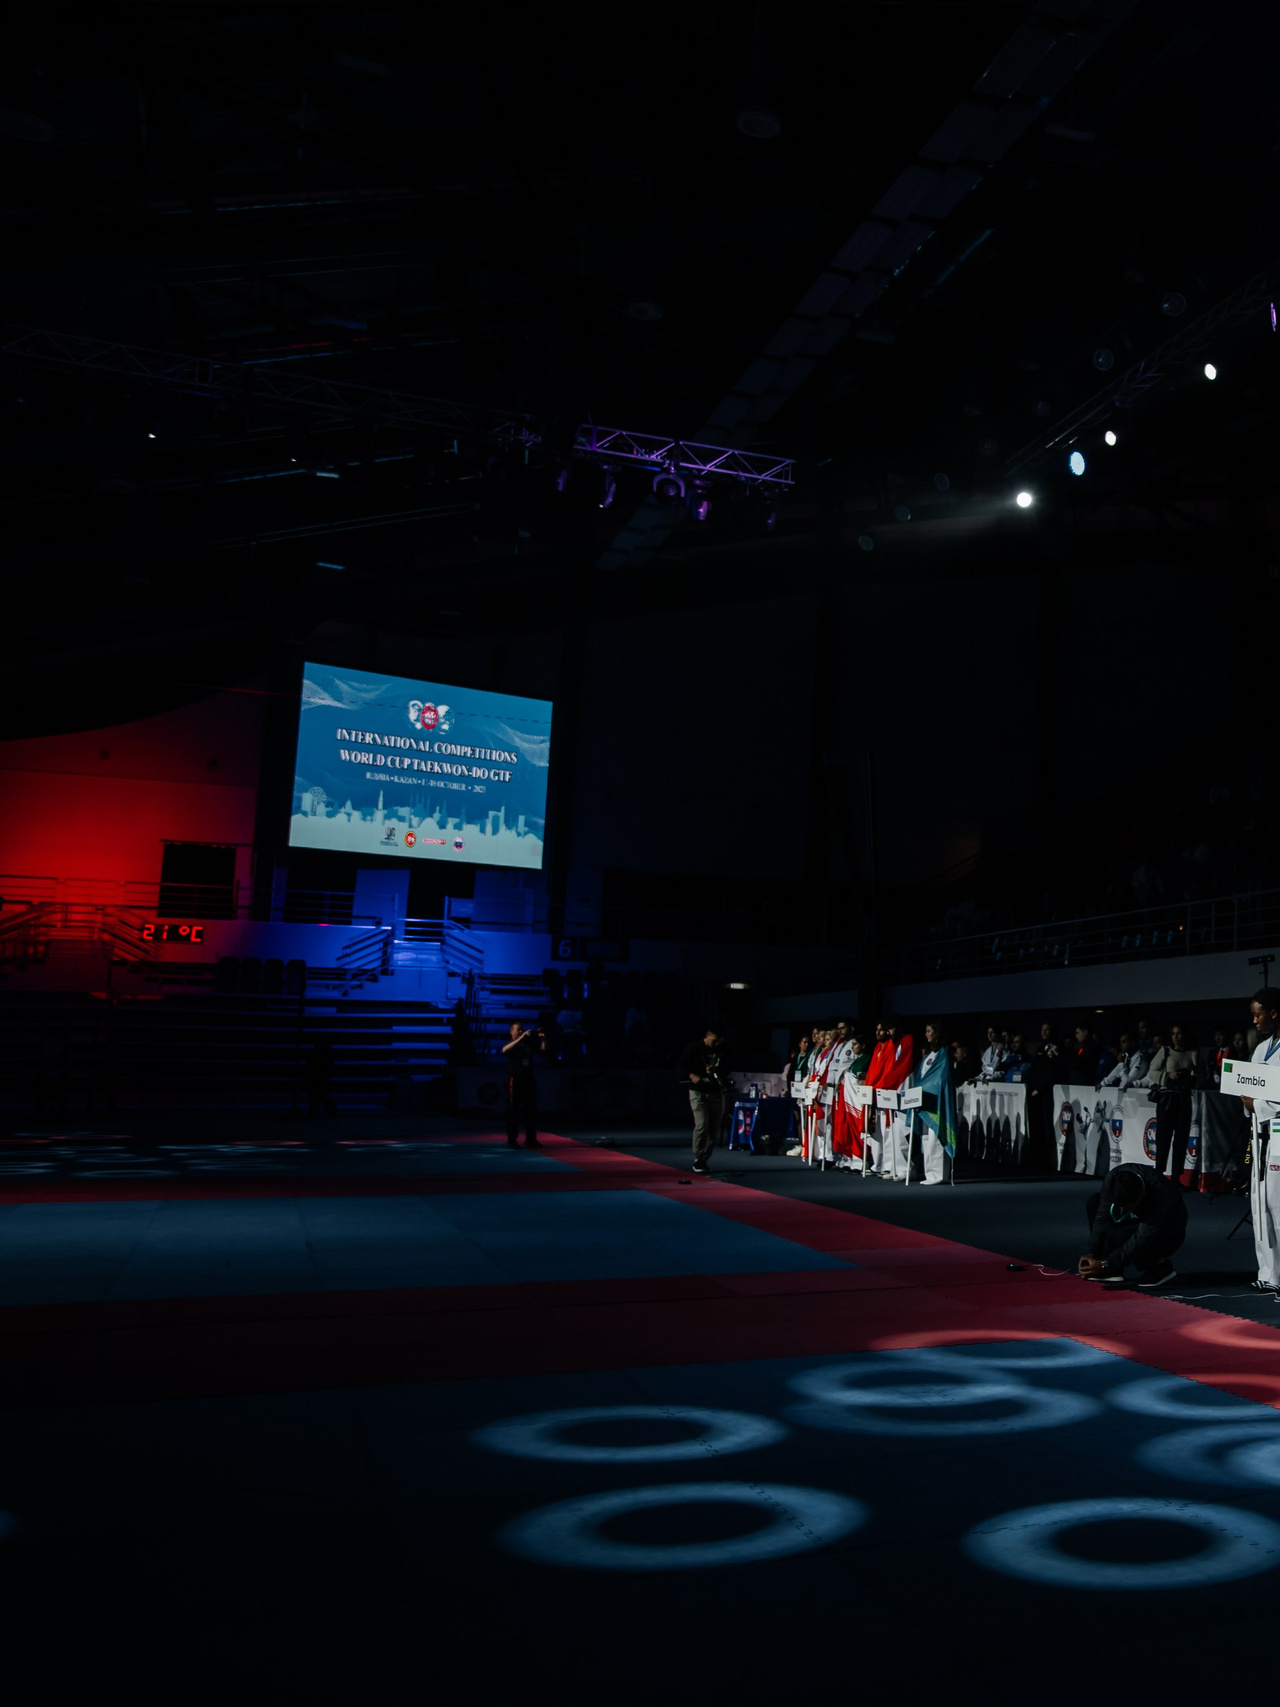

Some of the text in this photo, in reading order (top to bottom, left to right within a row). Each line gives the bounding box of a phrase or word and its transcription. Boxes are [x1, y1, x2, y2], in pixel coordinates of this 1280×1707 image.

[336, 728, 518, 764] INTERNATIONAL COMPETITIONS
[339, 749, 513, 782] WORLD CUP TAEKWON-DO GTF
[1236, 1073, 1266, 1088] Zambia
